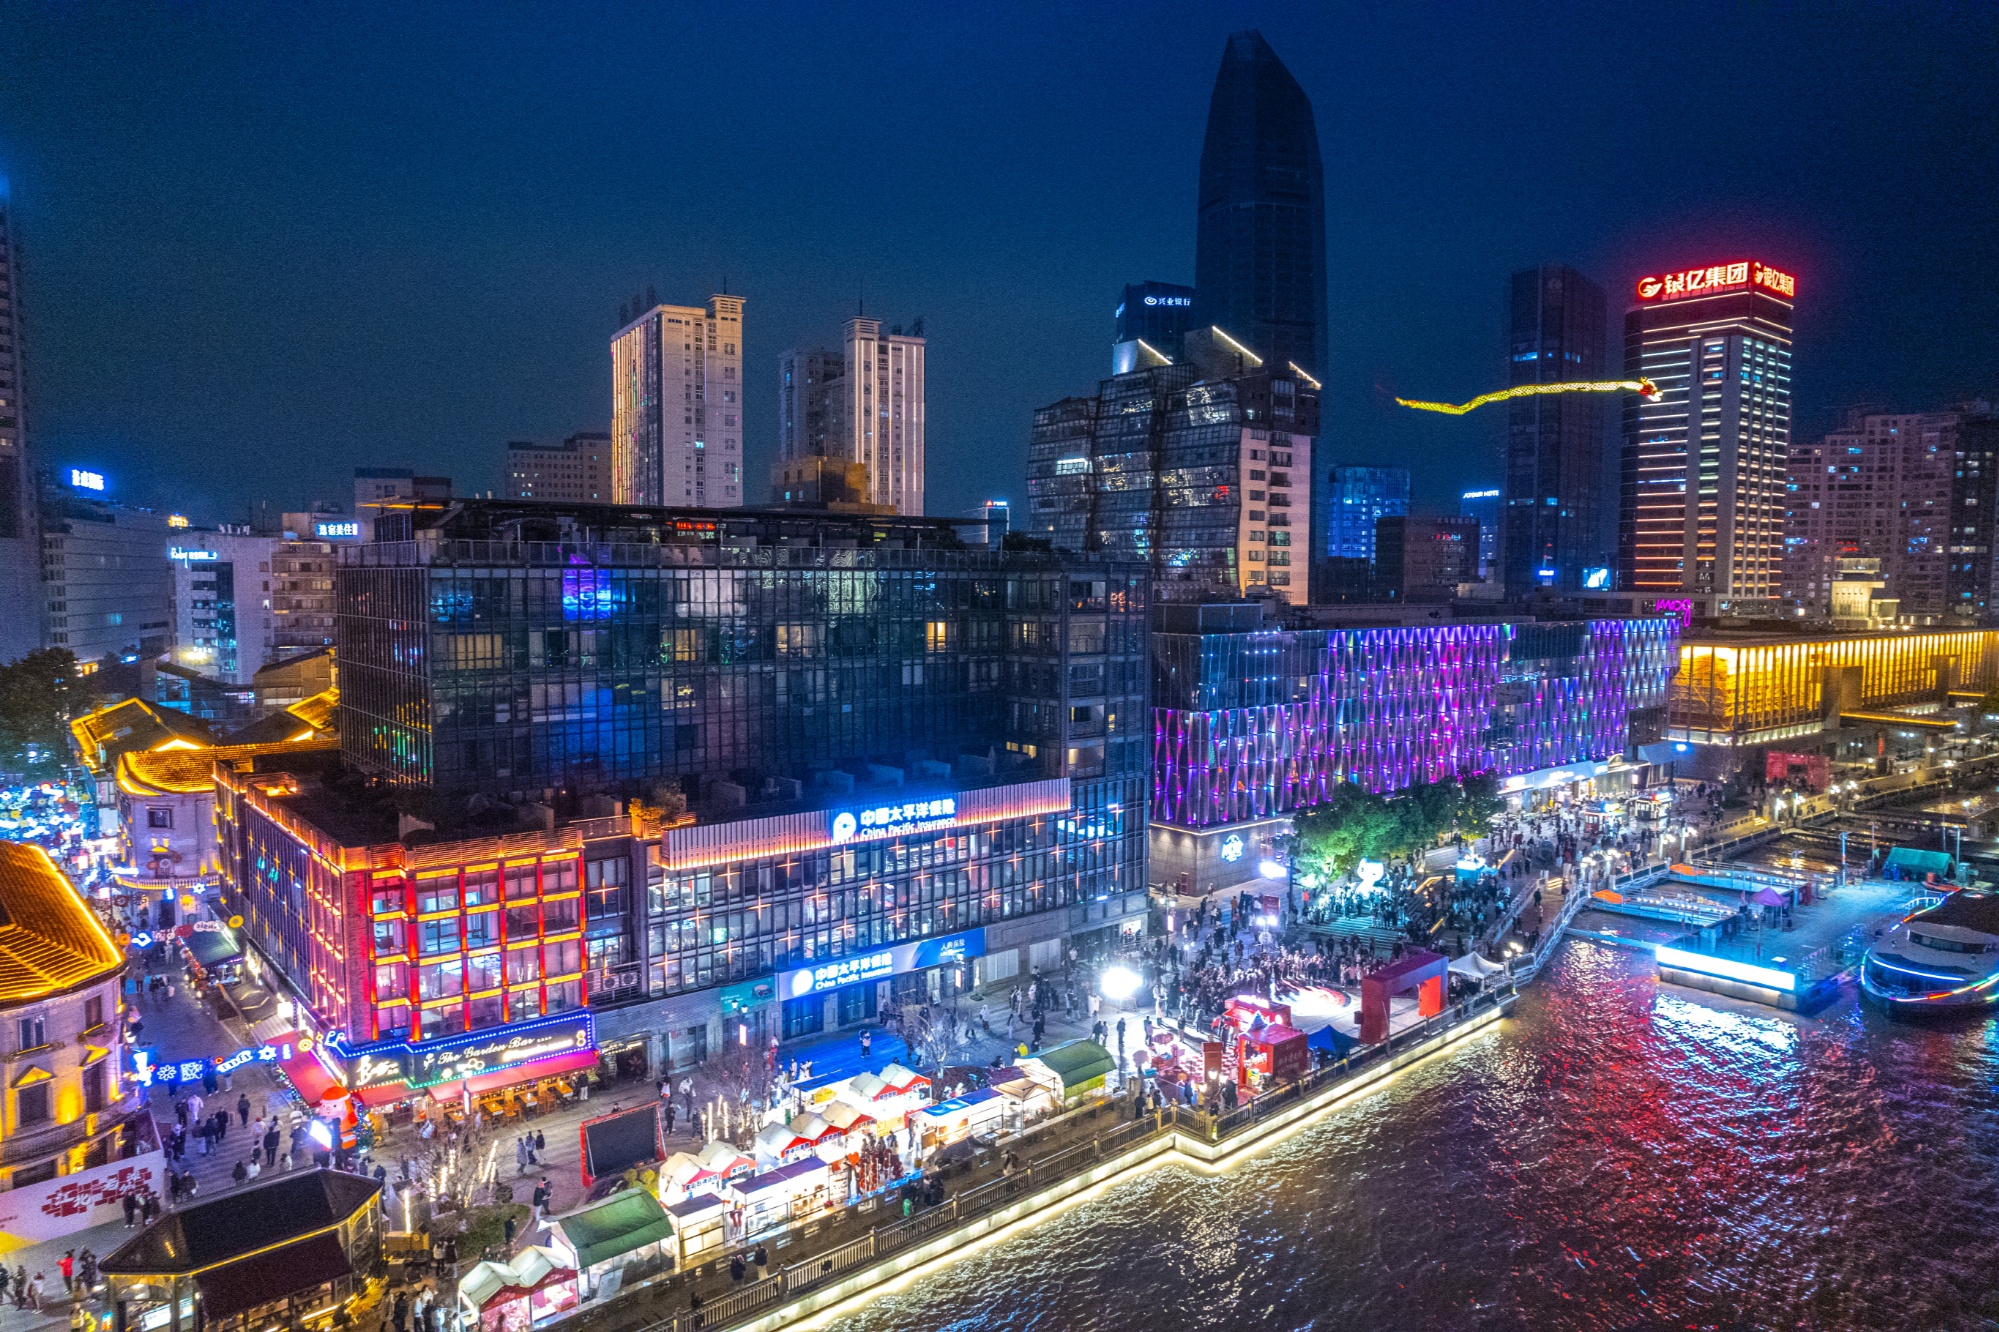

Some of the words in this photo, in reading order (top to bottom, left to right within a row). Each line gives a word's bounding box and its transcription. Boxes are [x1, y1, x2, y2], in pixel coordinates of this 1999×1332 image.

[1664, 261, 1749, 295] 银亿集团
[1763, 265, 1795, 297] 银亿集团
[1158, 297, 1191, 306] 兴业银行
[861, 826, 887, 839] China
[888, 821, 915, 837] Pacific
[917, 816, 956, 834] Insurance
[815, 980, 836, 991] China
[837, 974, 860, 985] Pacific
[437, 1051, 462, 1065] The
[464, 1042, 508, 1059] Garden
[509, 1035, 536, 1049] Bar
